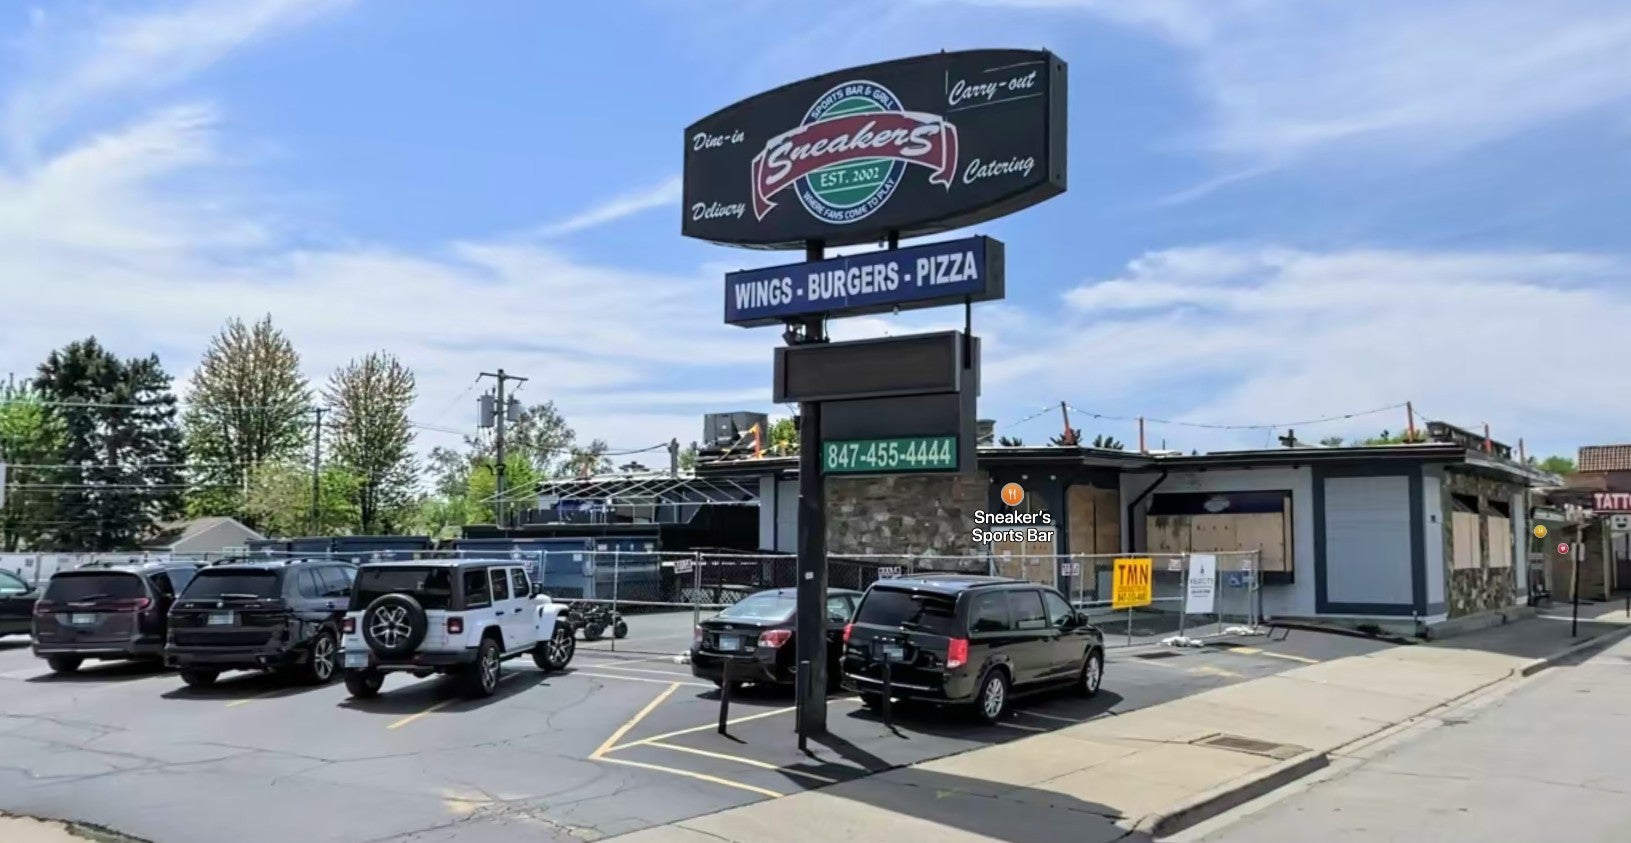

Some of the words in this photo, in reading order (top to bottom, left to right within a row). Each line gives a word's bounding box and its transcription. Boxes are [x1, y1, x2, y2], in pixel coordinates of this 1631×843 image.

[811, 89, 844, 119] SPORTS
[845, 85, 864, 96] BAR
[865, 85, 871, 95] &
[872, 88, 893, 111] GRILL
[948, 70, 1037, 106] Carry-out
[693, 130, 745, 151] Dine-in
[820, 170, 850, 187] EST.
[853, 167, 880, 182] 2002
[963, 157, 1035, 184] Catering
[691, 201, 746, 221] Delivery
[803, 191, 825, 216] WHERE
[824, 208, 844, 221] FANS
[844, 205, 868, 220] COME
[867, 197, 878, 210] TO
[878, 178, 895, 202] PLAY
[735, 277, 793, 310] WINGS
[808, 261, 899, 301] BURGERS
[917, 251, 978, 287] PIZZA
[827, 440, 951, 470] 847-455-4444
[1118, 564, 1149, 585] TMN
